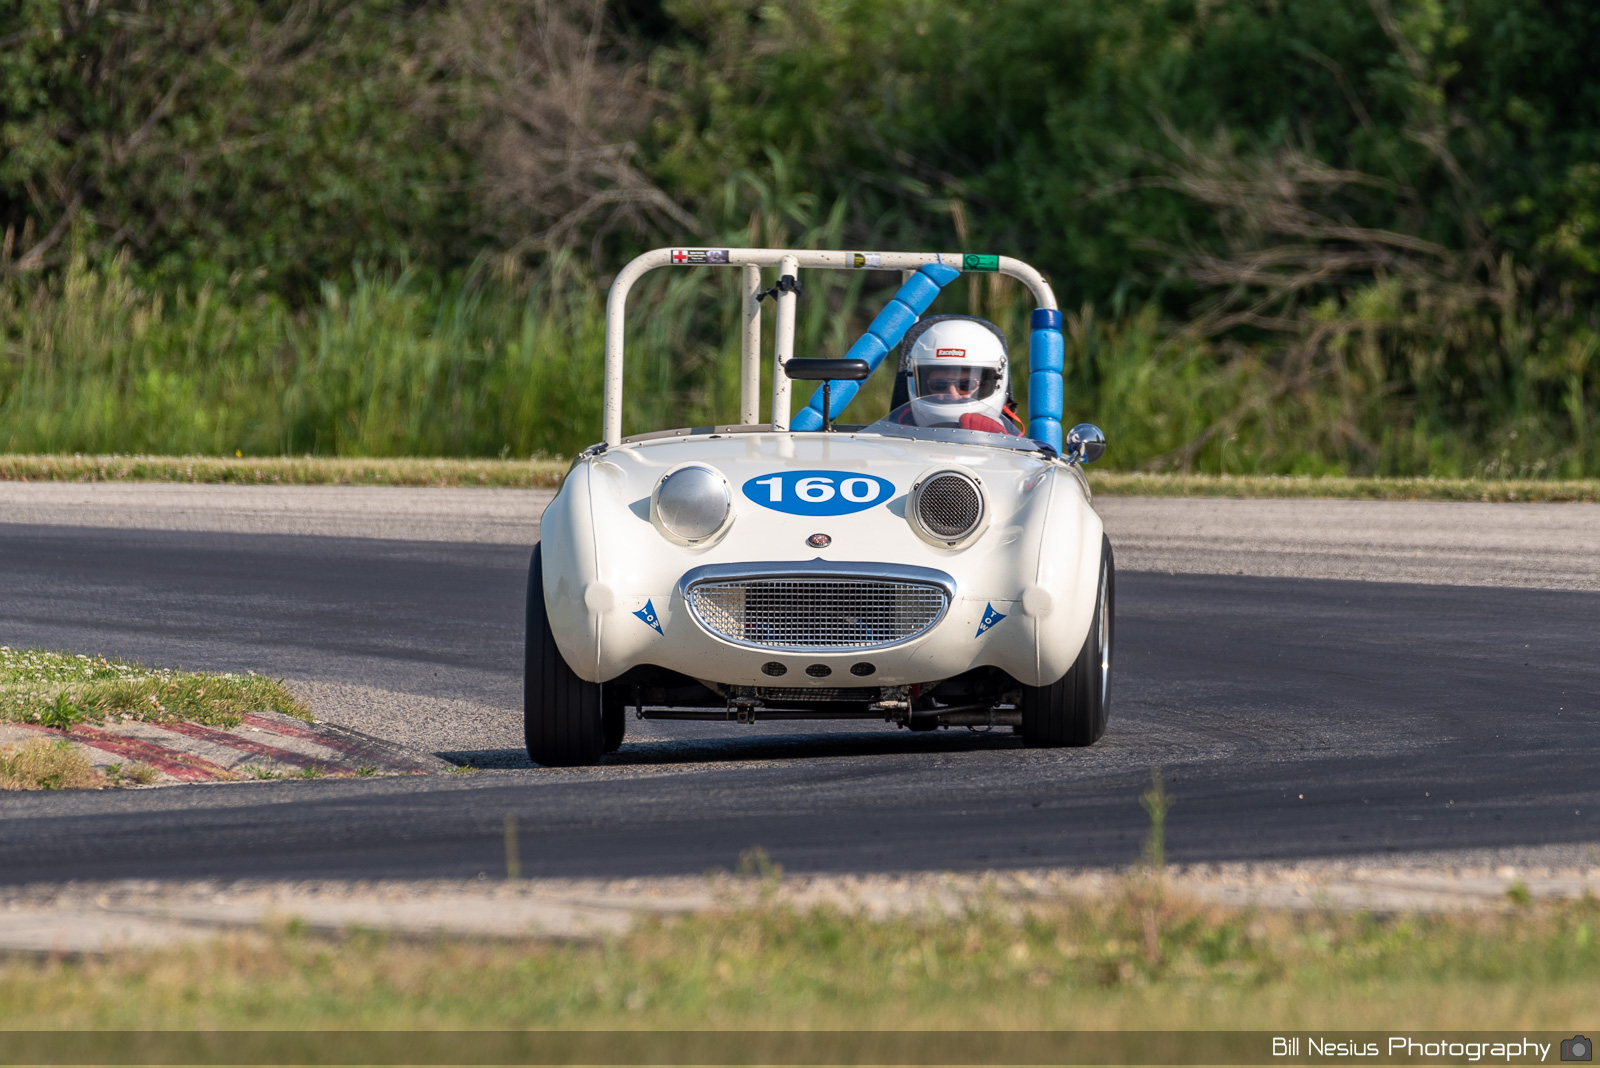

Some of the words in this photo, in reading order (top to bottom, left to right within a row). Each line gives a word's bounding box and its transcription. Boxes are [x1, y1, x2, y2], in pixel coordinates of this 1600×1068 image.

[756, 477, 880, 503] 160
[641, 607, 659, 629] TOW
[980, 610, 997, 631] TOW
